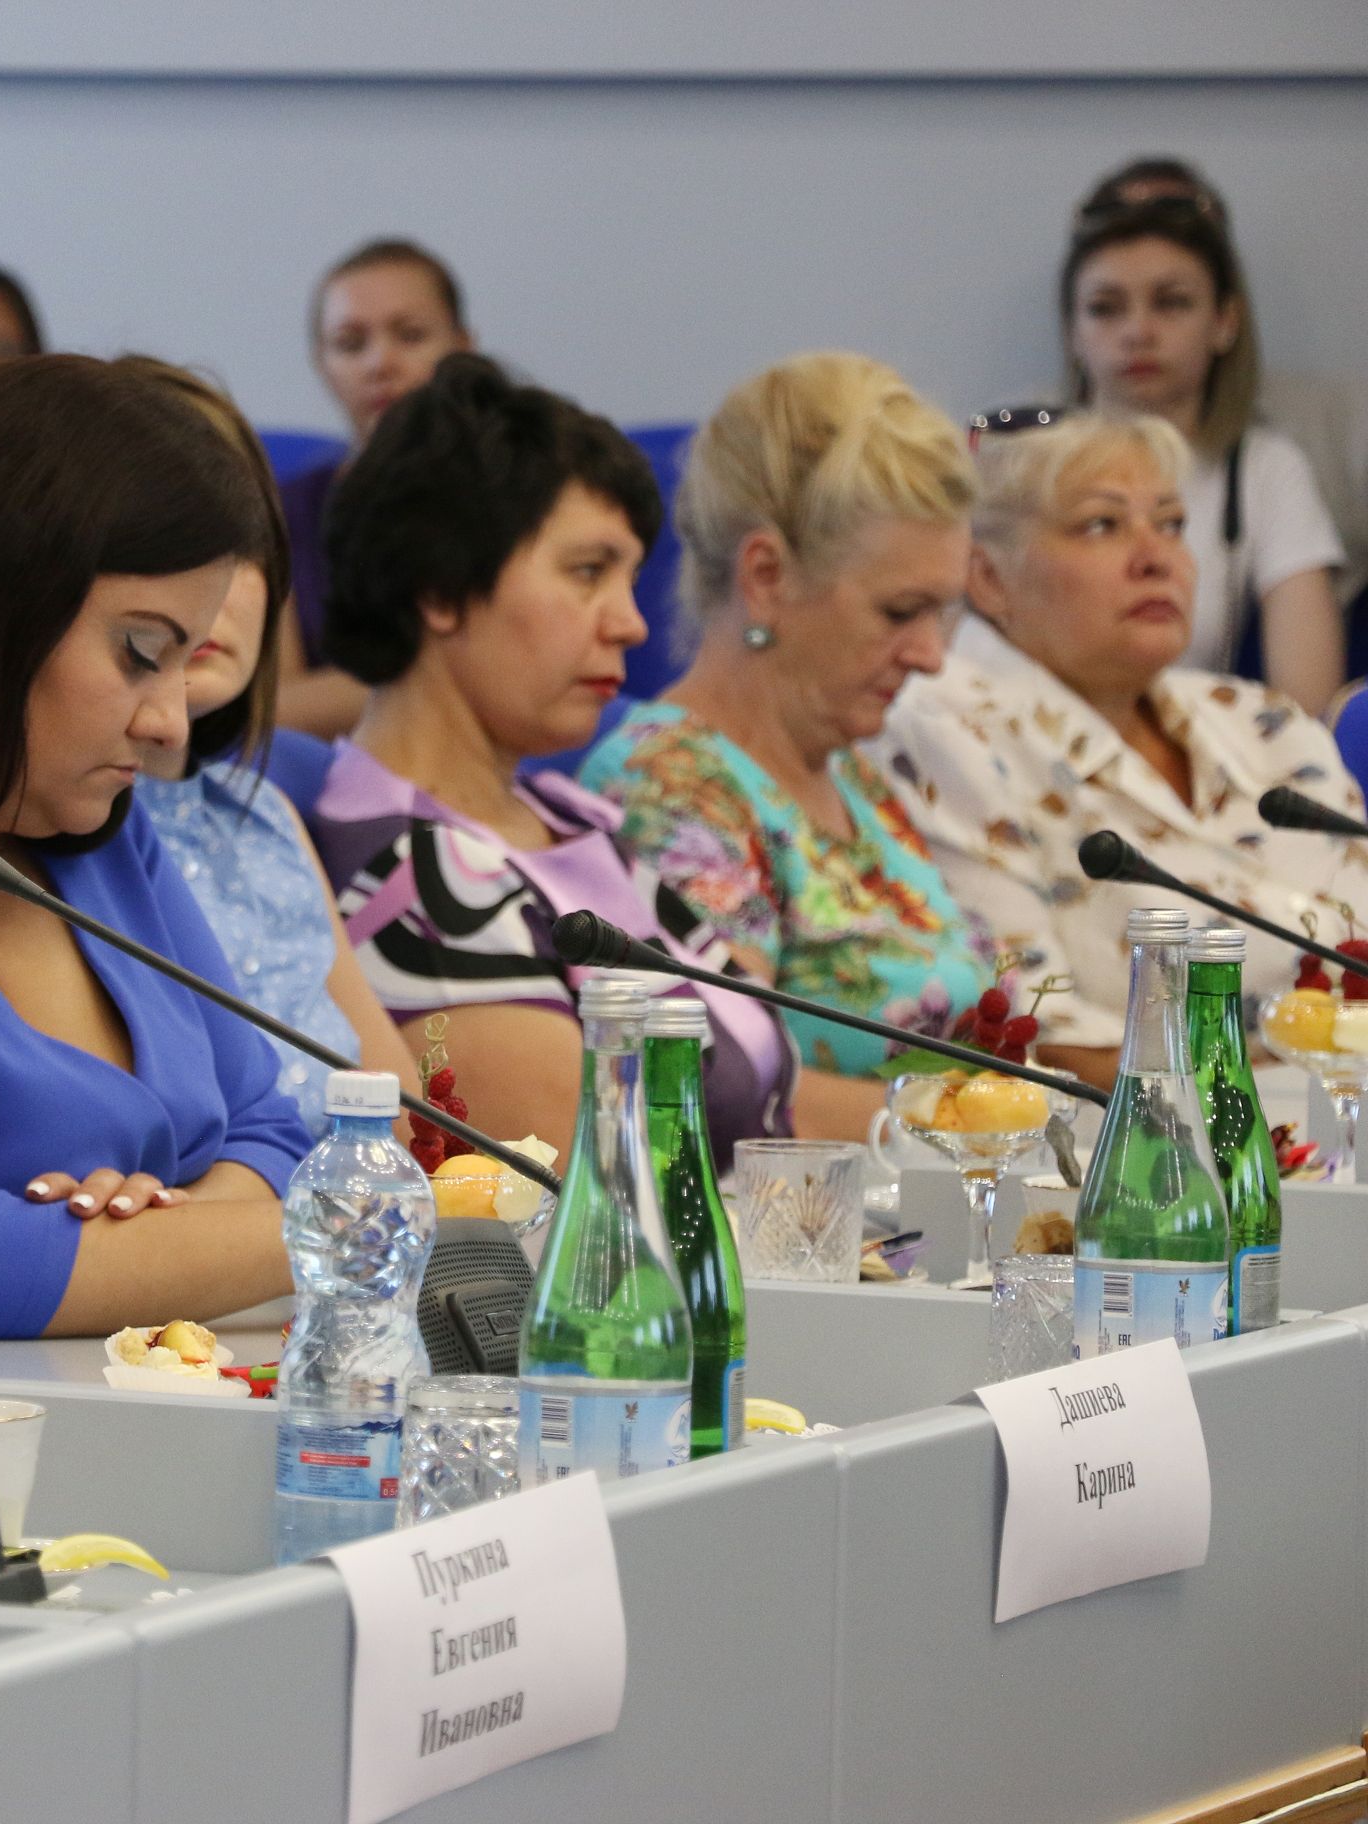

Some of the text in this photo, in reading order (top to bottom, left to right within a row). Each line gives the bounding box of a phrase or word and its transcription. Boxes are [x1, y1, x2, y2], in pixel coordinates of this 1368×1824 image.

[1048, 1380, 1126, 1433] Дашиева
[1075, 1458, 1136, 1510] Карина
[411, 1534, 511, 1606] Пуркина
[430, 1613, 518, 1677] Евгения
[419, 1689, 524, 1758] Ивановна
